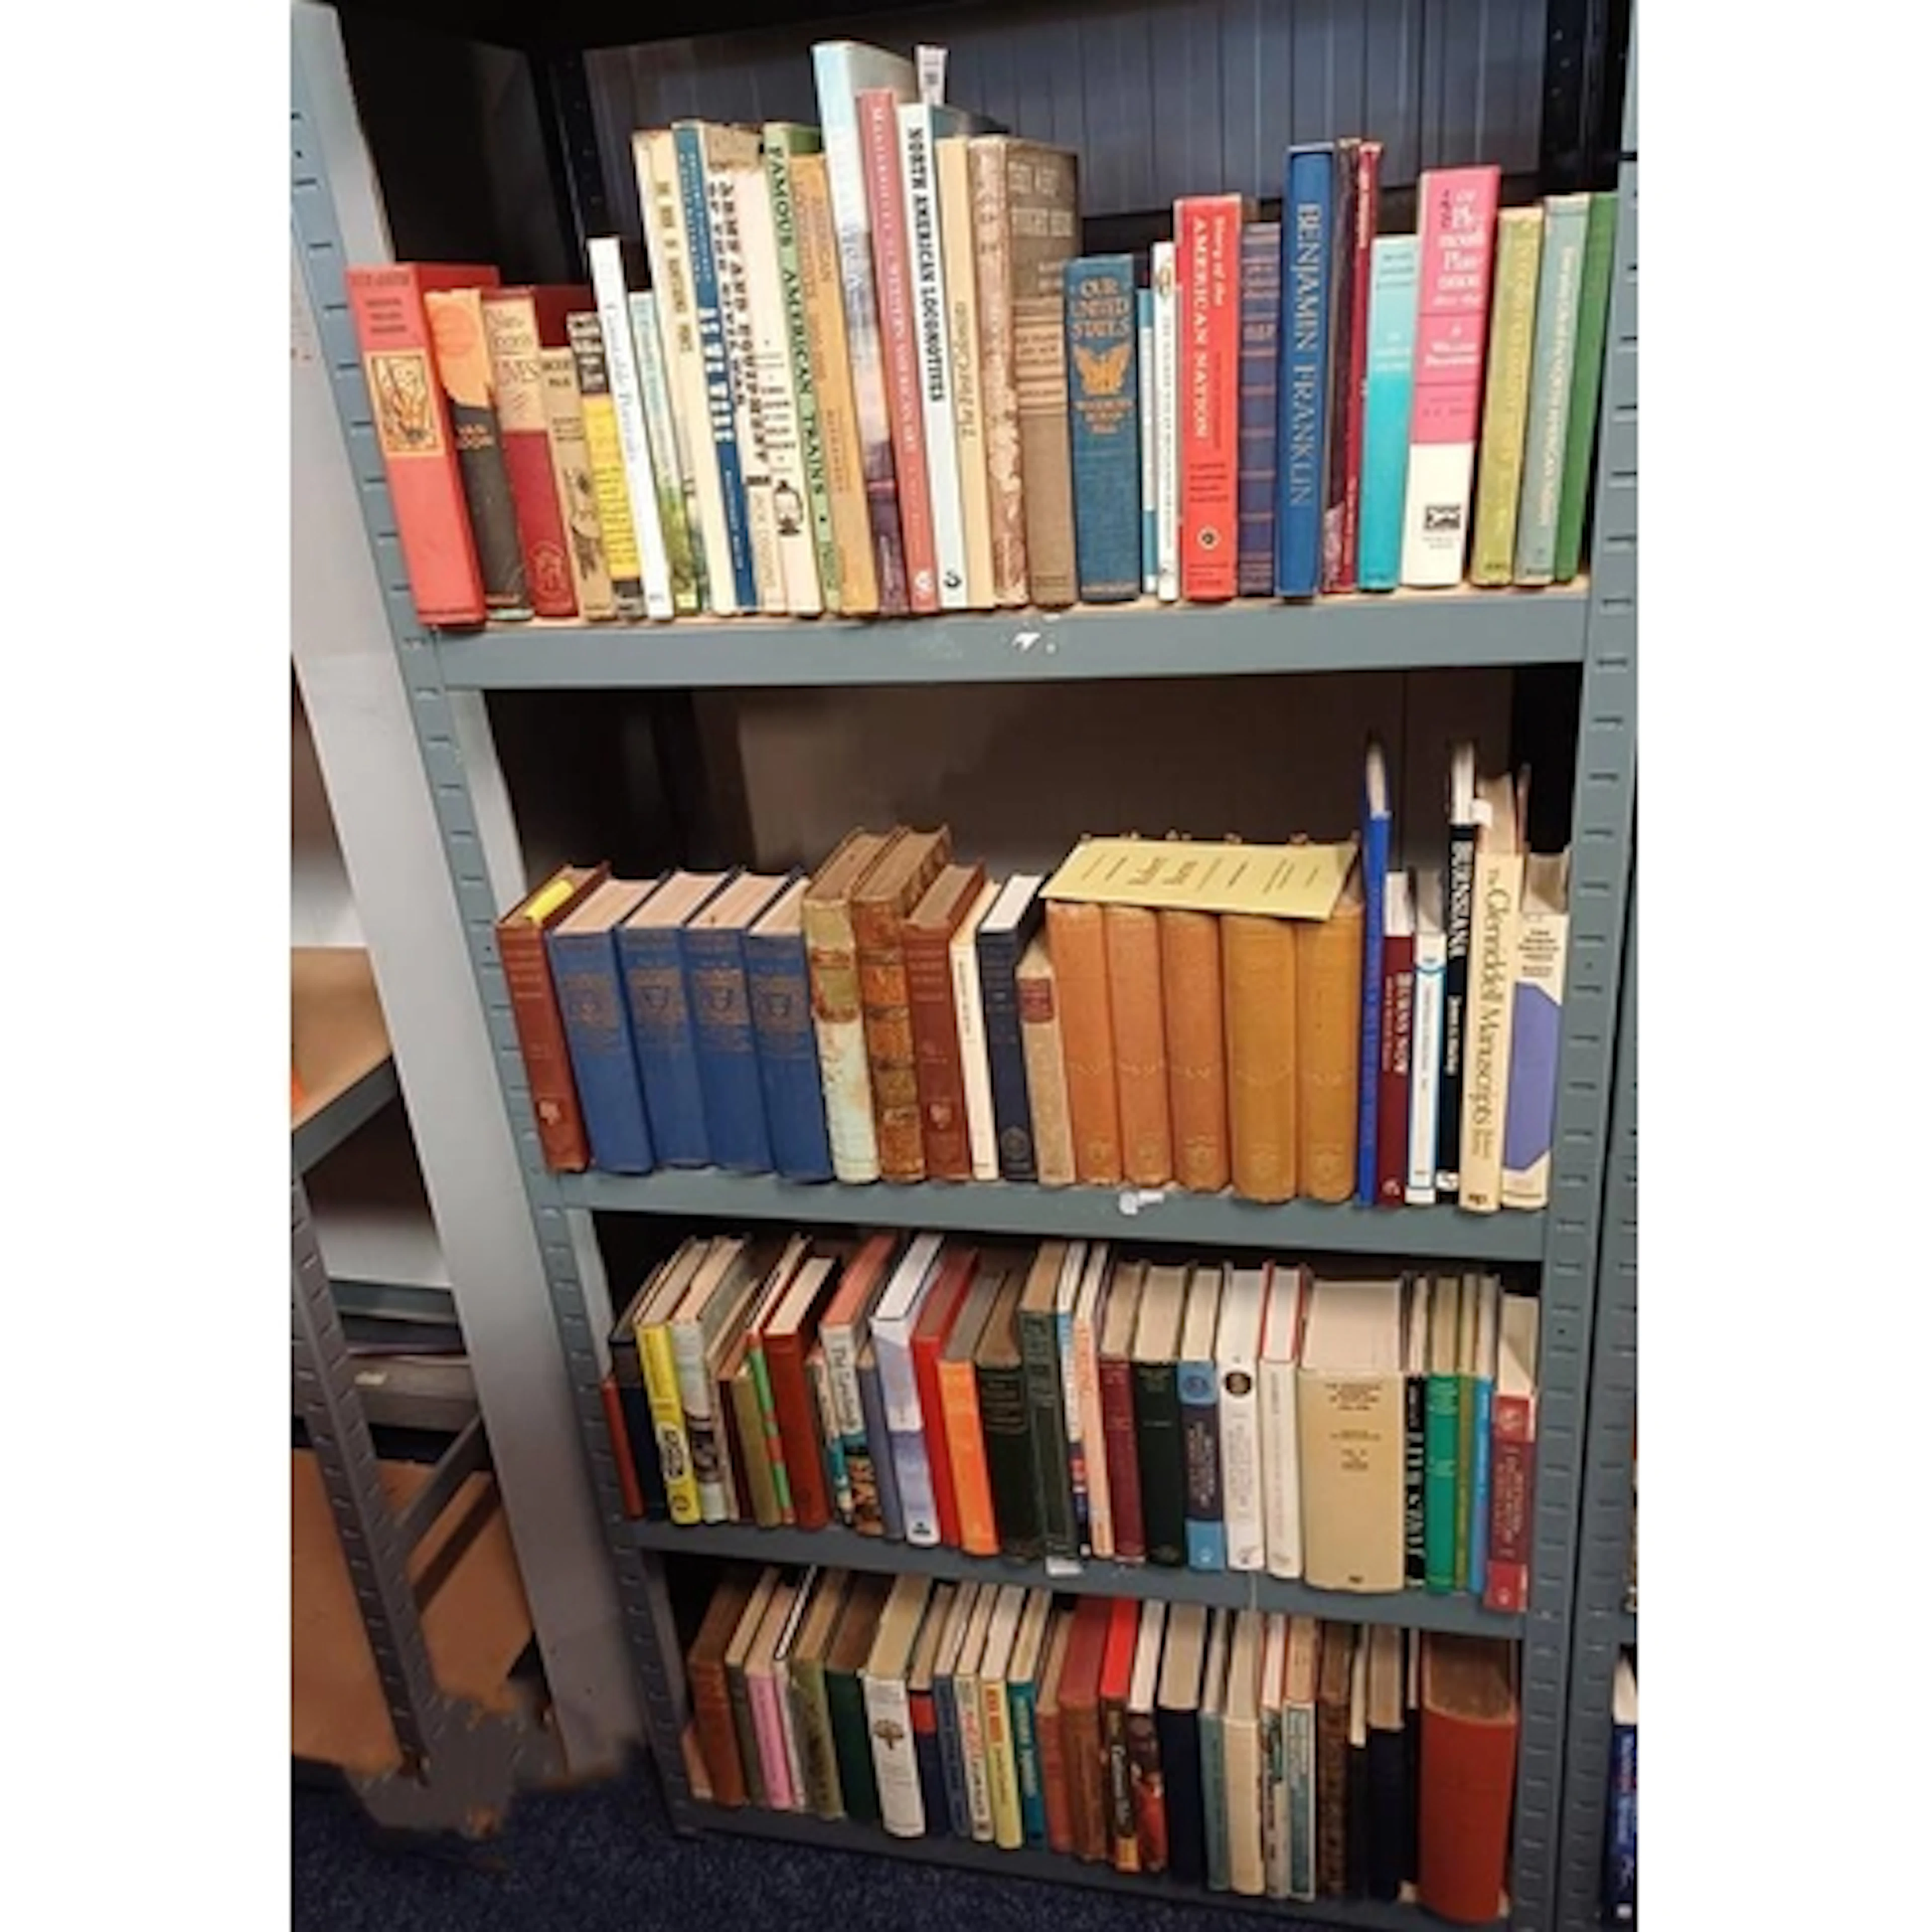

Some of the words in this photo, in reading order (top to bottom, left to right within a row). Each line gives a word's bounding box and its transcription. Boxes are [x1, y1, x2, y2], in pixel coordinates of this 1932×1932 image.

[707, 181, 720, 213] OF
[909, 127, 929, 190] NORTH
[712, 220, 729, 272] THE
[718, 181, 742, 252] ARMS
[914, 194, 936, 283] AMERICAN
[729, 259, 749, 314] AND
[1191, 215, 1209, 345] AMERICAN
[1212, 261, 1228, 283] of
[1212, 285, 1227, 307] the
[1291, 203, 1323, 351] BENJAMIN
[720, 281, 742, 352] CIVIL
[768, 146, 794, 248] FAMOUS
[782, 269, 813, 395] AMERICAN
[802, 416, 824, 495] TRAINS
[921, 286, 945, 402] LOCOMOTIVES
[737, 322, 771, 463] EQUIPMENT
[1192, 353, 1210, 440] NATION
[1289, 363, 1319, 507] FRANKLIN
[1483, 888, 1510, 1004] Glenriddell
[1468, 1008, 1503, 1127] Manuscripts
